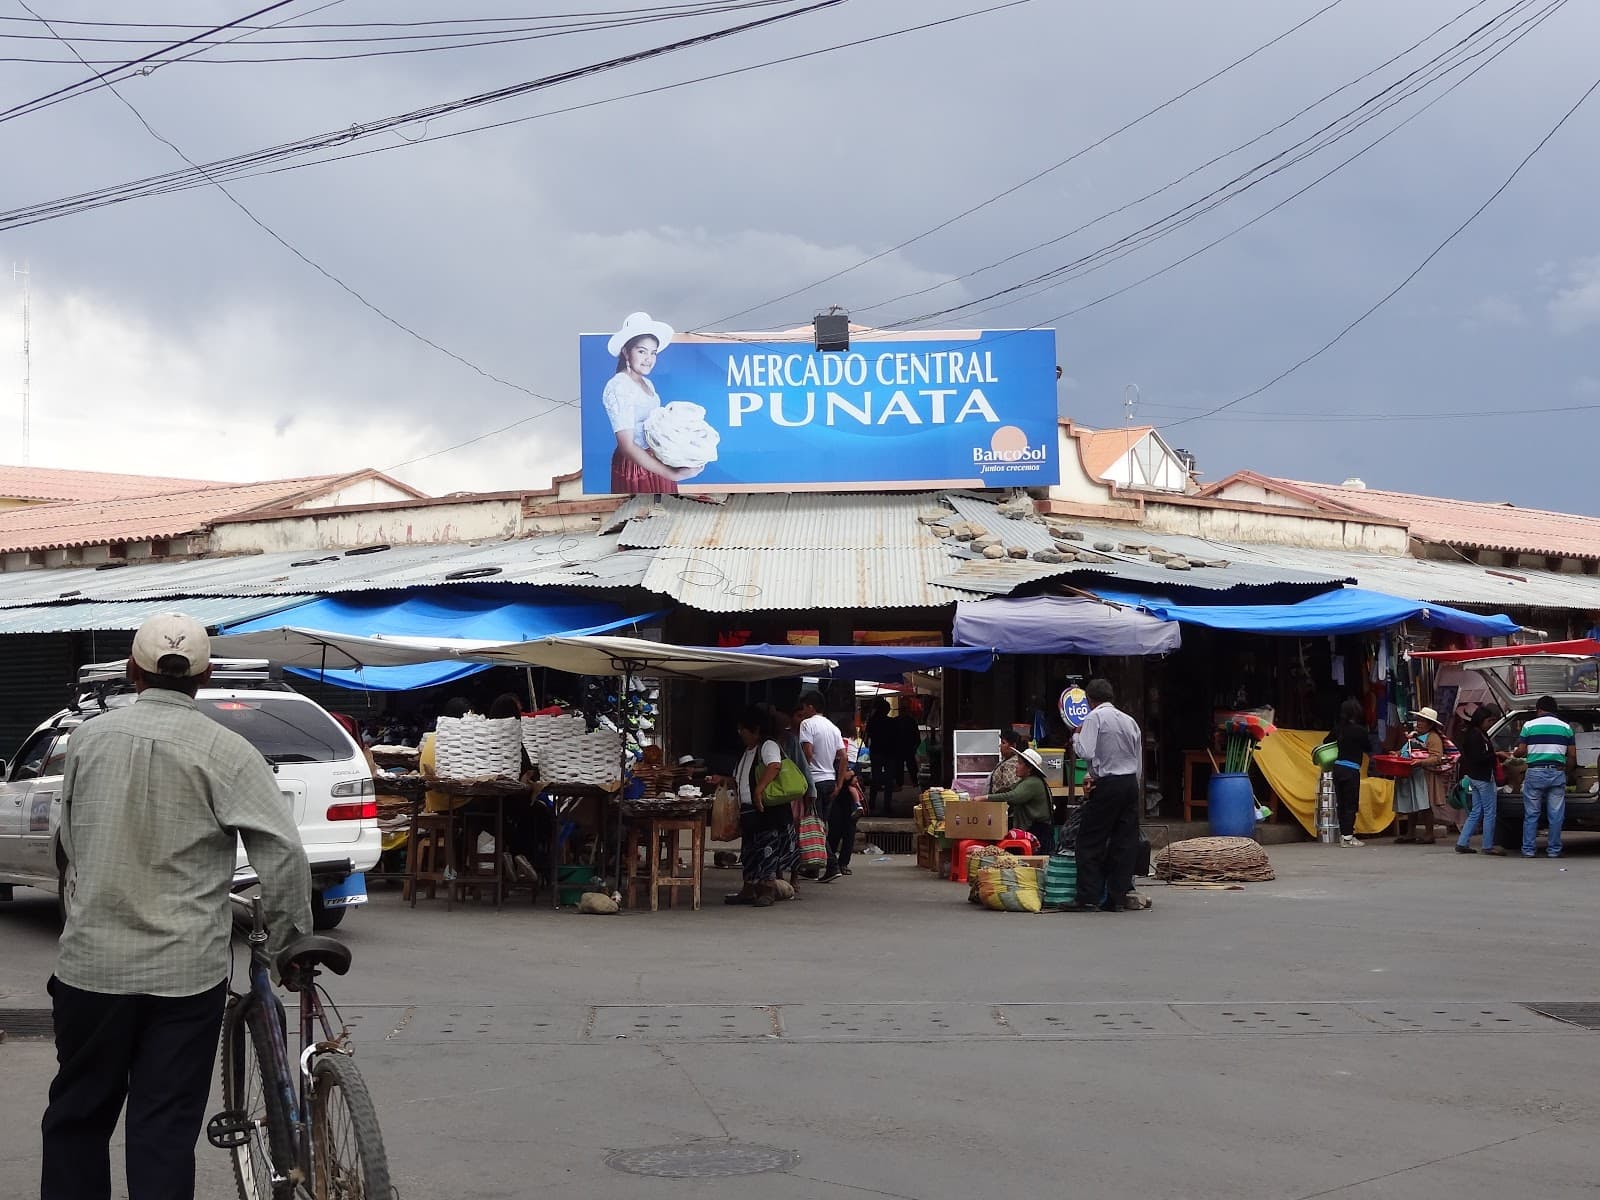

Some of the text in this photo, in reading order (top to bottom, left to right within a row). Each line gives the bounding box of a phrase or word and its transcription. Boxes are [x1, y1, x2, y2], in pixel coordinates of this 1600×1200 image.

[727, 351, 998, 387] MERCADO CENTRAL
[727, 388, 1000, 427] PUNATA
[973, 444, 1046, 461] BancoSol
[1006, 464, 1040, 472] crecemos
